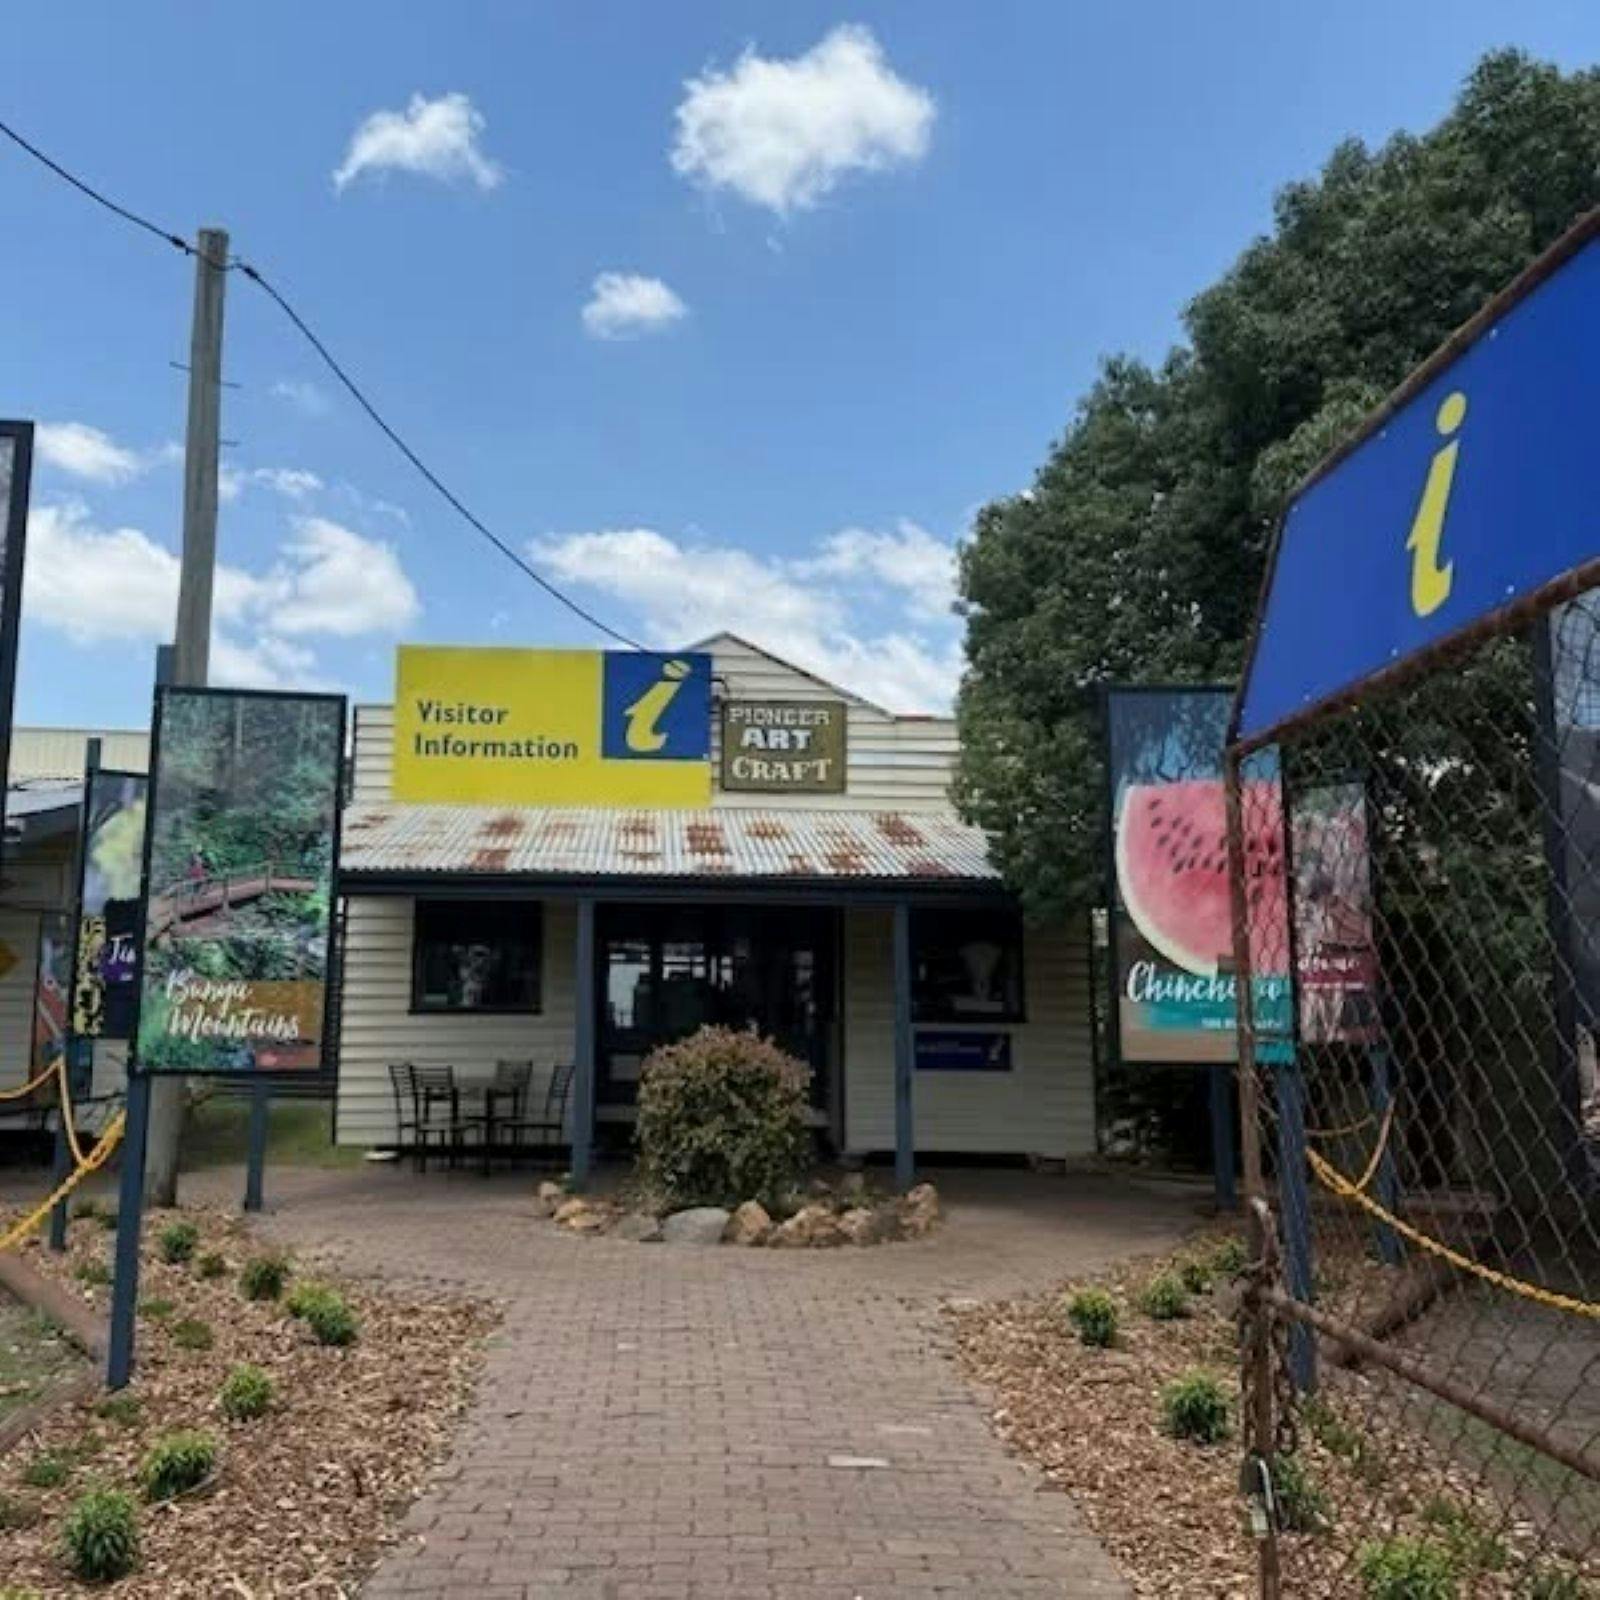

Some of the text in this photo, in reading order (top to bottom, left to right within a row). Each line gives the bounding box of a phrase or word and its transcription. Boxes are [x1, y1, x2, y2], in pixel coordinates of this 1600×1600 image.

[416, 699, 509, 725] Visitor
[729, 708, 830, 726] PIONEER
[414, 732, 579, 759] Information
[740, 727, 812, 750] ART
[731, 756, 832, 782] CRAFT
